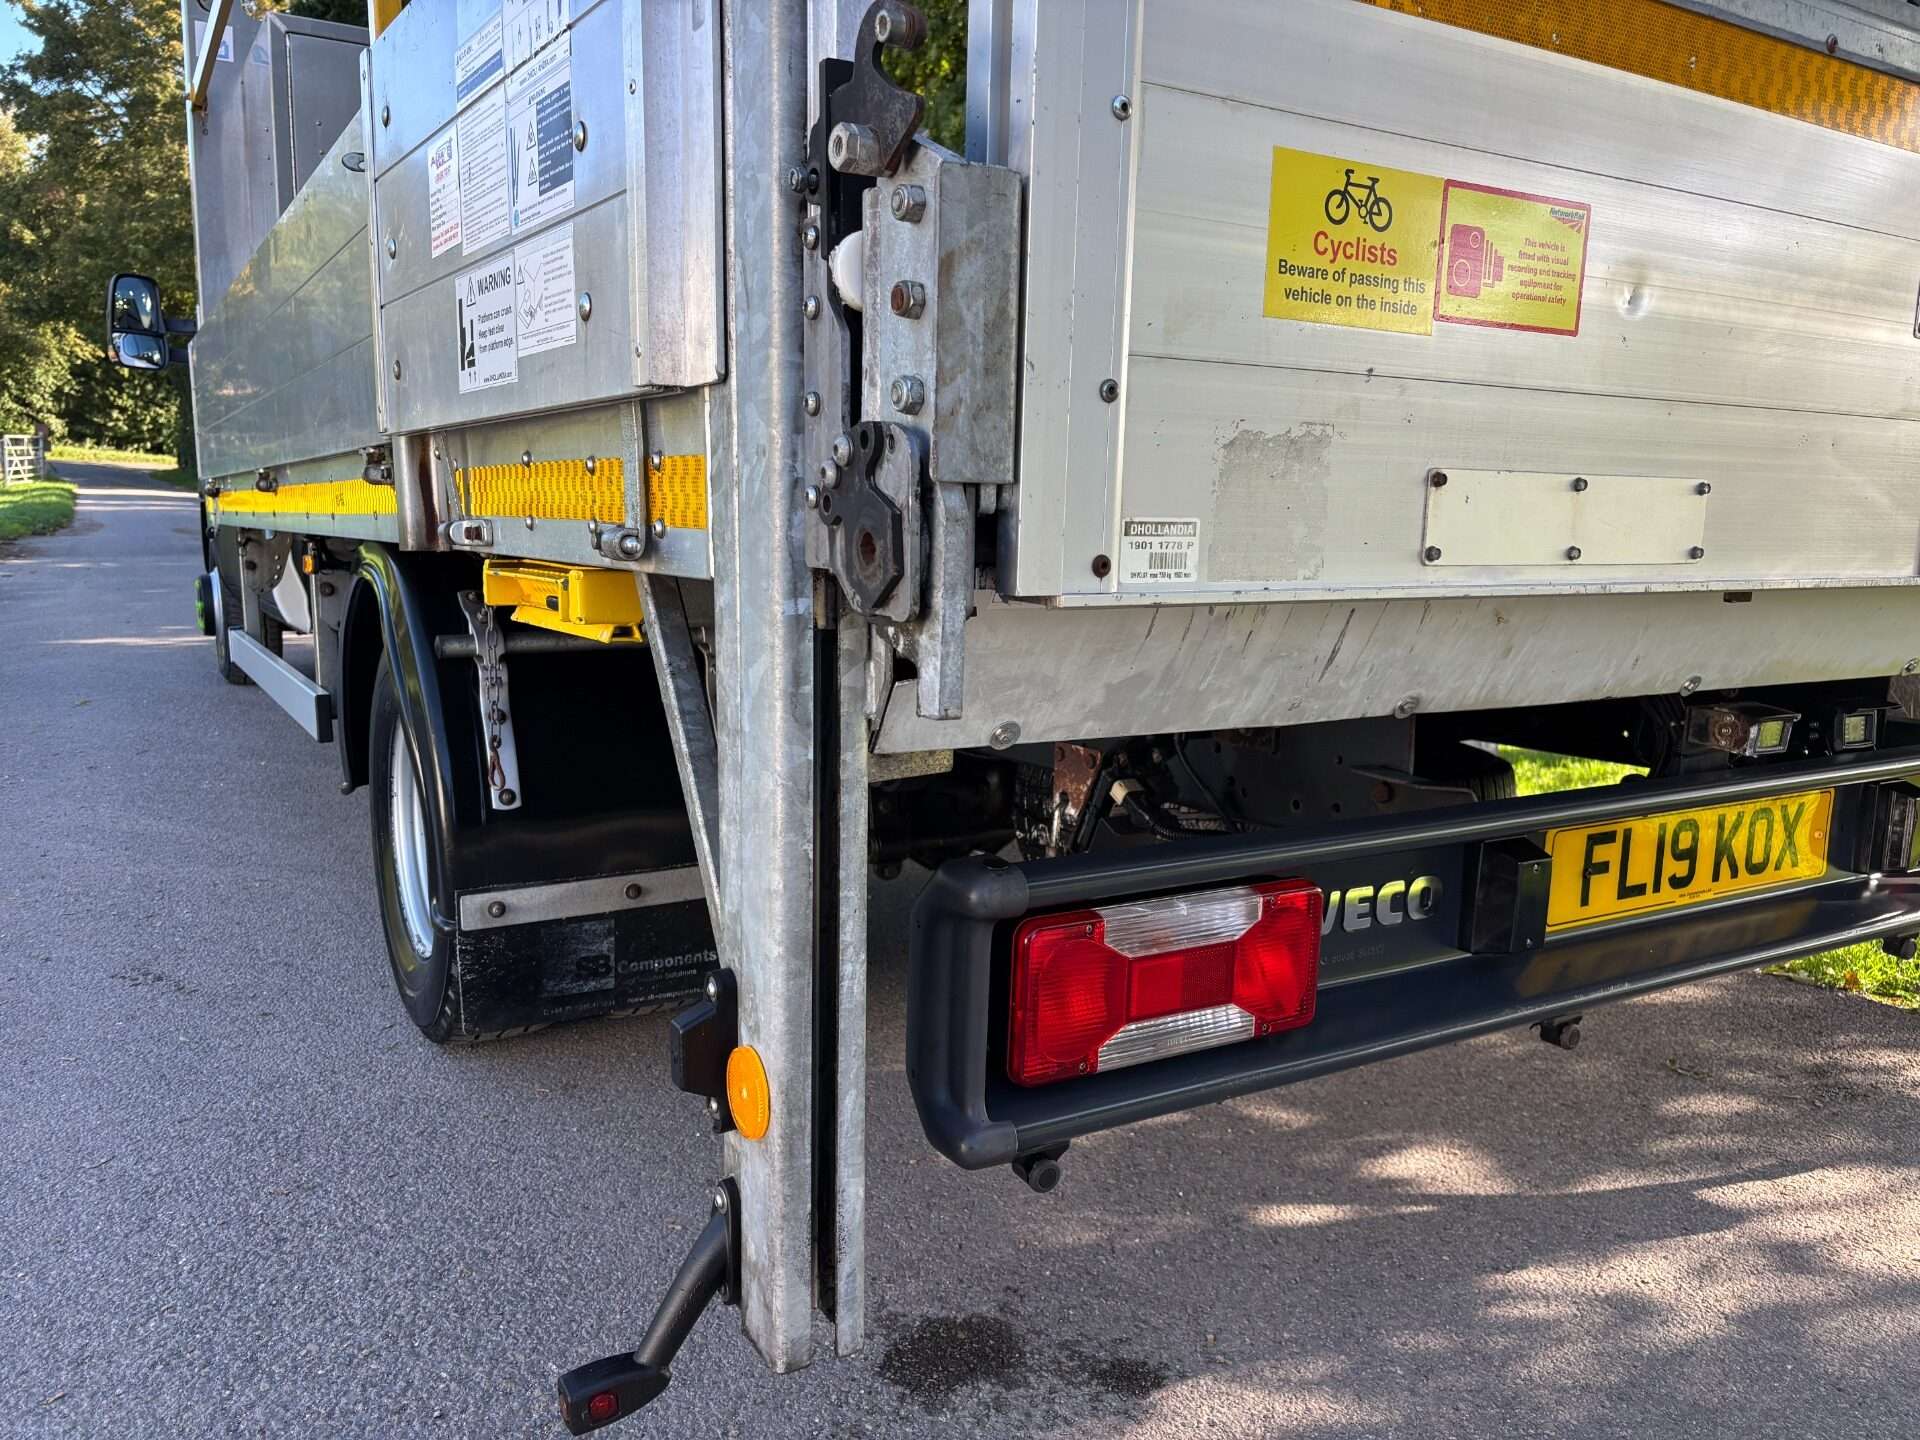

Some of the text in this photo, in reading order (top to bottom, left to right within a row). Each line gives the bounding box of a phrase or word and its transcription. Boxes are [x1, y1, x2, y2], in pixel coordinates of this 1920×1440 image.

[1313, 230, 1397, 266] Cyclists
[1524, 238, 1566, 253] This vehicle is
[1519, 250, 1568, 266] fitted with visual
[476, 266, 511, 296] WARNING
[1278, 259, 1426, 294] Beware of passing this
[1508, 264, 1576, 282] recording and tracking
[1519, 279, 1563, 291] equipment for
[1284, 286, 1417, 316] vehicle on the inside
[1511, 291, 1567, 307] operational safety
[1130, 523, 1194, 535] DHOLLANDIA
[1129, 541, 1194, 550] 1901 1778 P
[1580, 801, 1806, 908] FL19 KOX
[1321, 876, 1443, 936] VECO
[617, 951, 718, 974] Components
